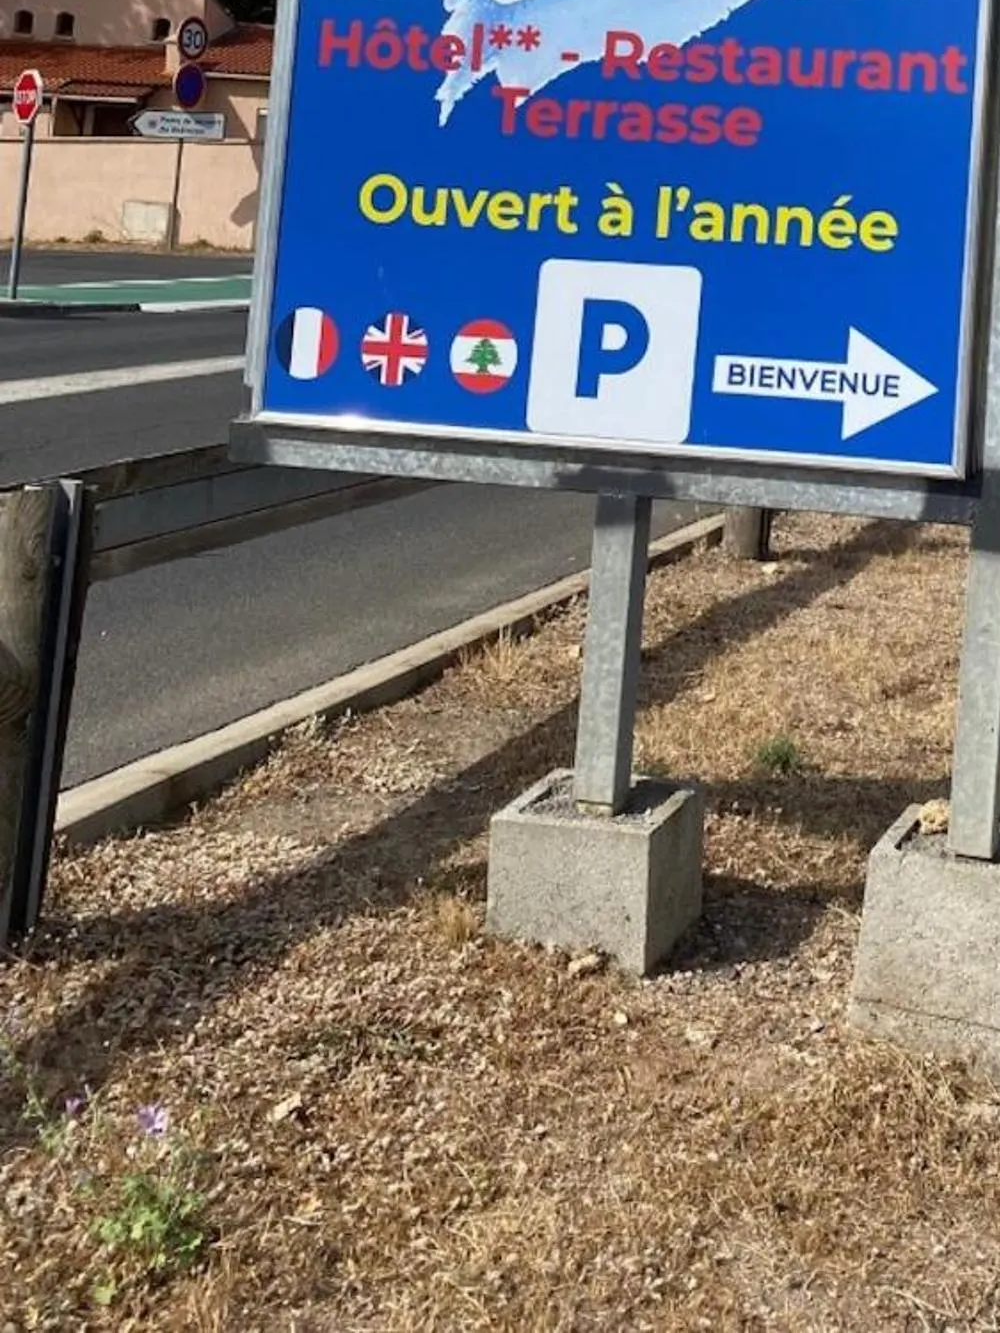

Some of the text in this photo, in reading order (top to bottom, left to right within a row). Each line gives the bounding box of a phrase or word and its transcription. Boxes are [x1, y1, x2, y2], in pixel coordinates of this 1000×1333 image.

[183, 29, 204, 49] 30
[604, 31, 967, 92] Restaurant
[493, 87, 763, 145] Terrasse
[359, 173, 579, 232] Ouvert
[598, 183, 633, 237] à
[575, 298, 650, 399] P
[727, 364, 901, 398] BIENVENUE
